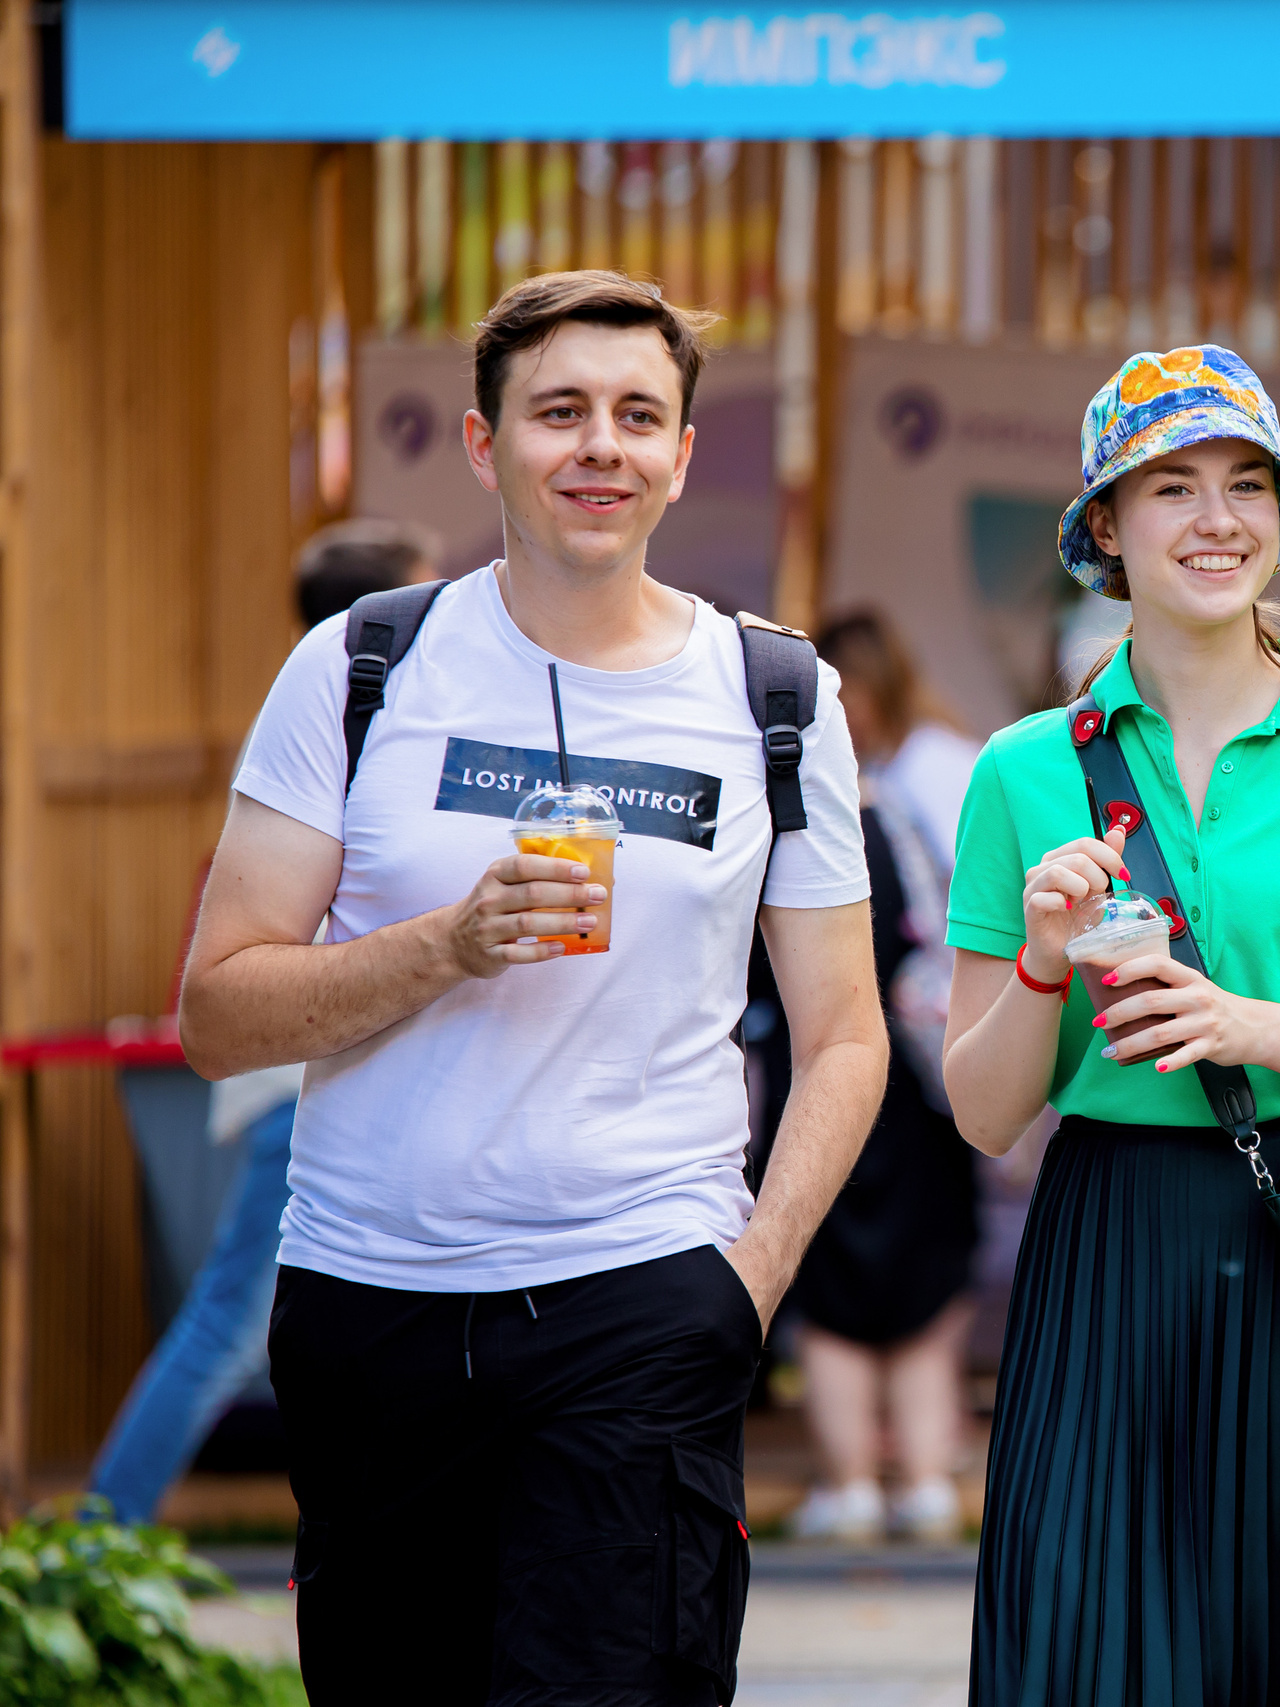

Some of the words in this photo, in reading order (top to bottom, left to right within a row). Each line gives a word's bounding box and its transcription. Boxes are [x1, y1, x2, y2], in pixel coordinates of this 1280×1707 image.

[668, 12, 1007, 89] ИМПЭКС
[462, 768, 525, 793] LOST
[596, 785, 698, 818] ONTROL
